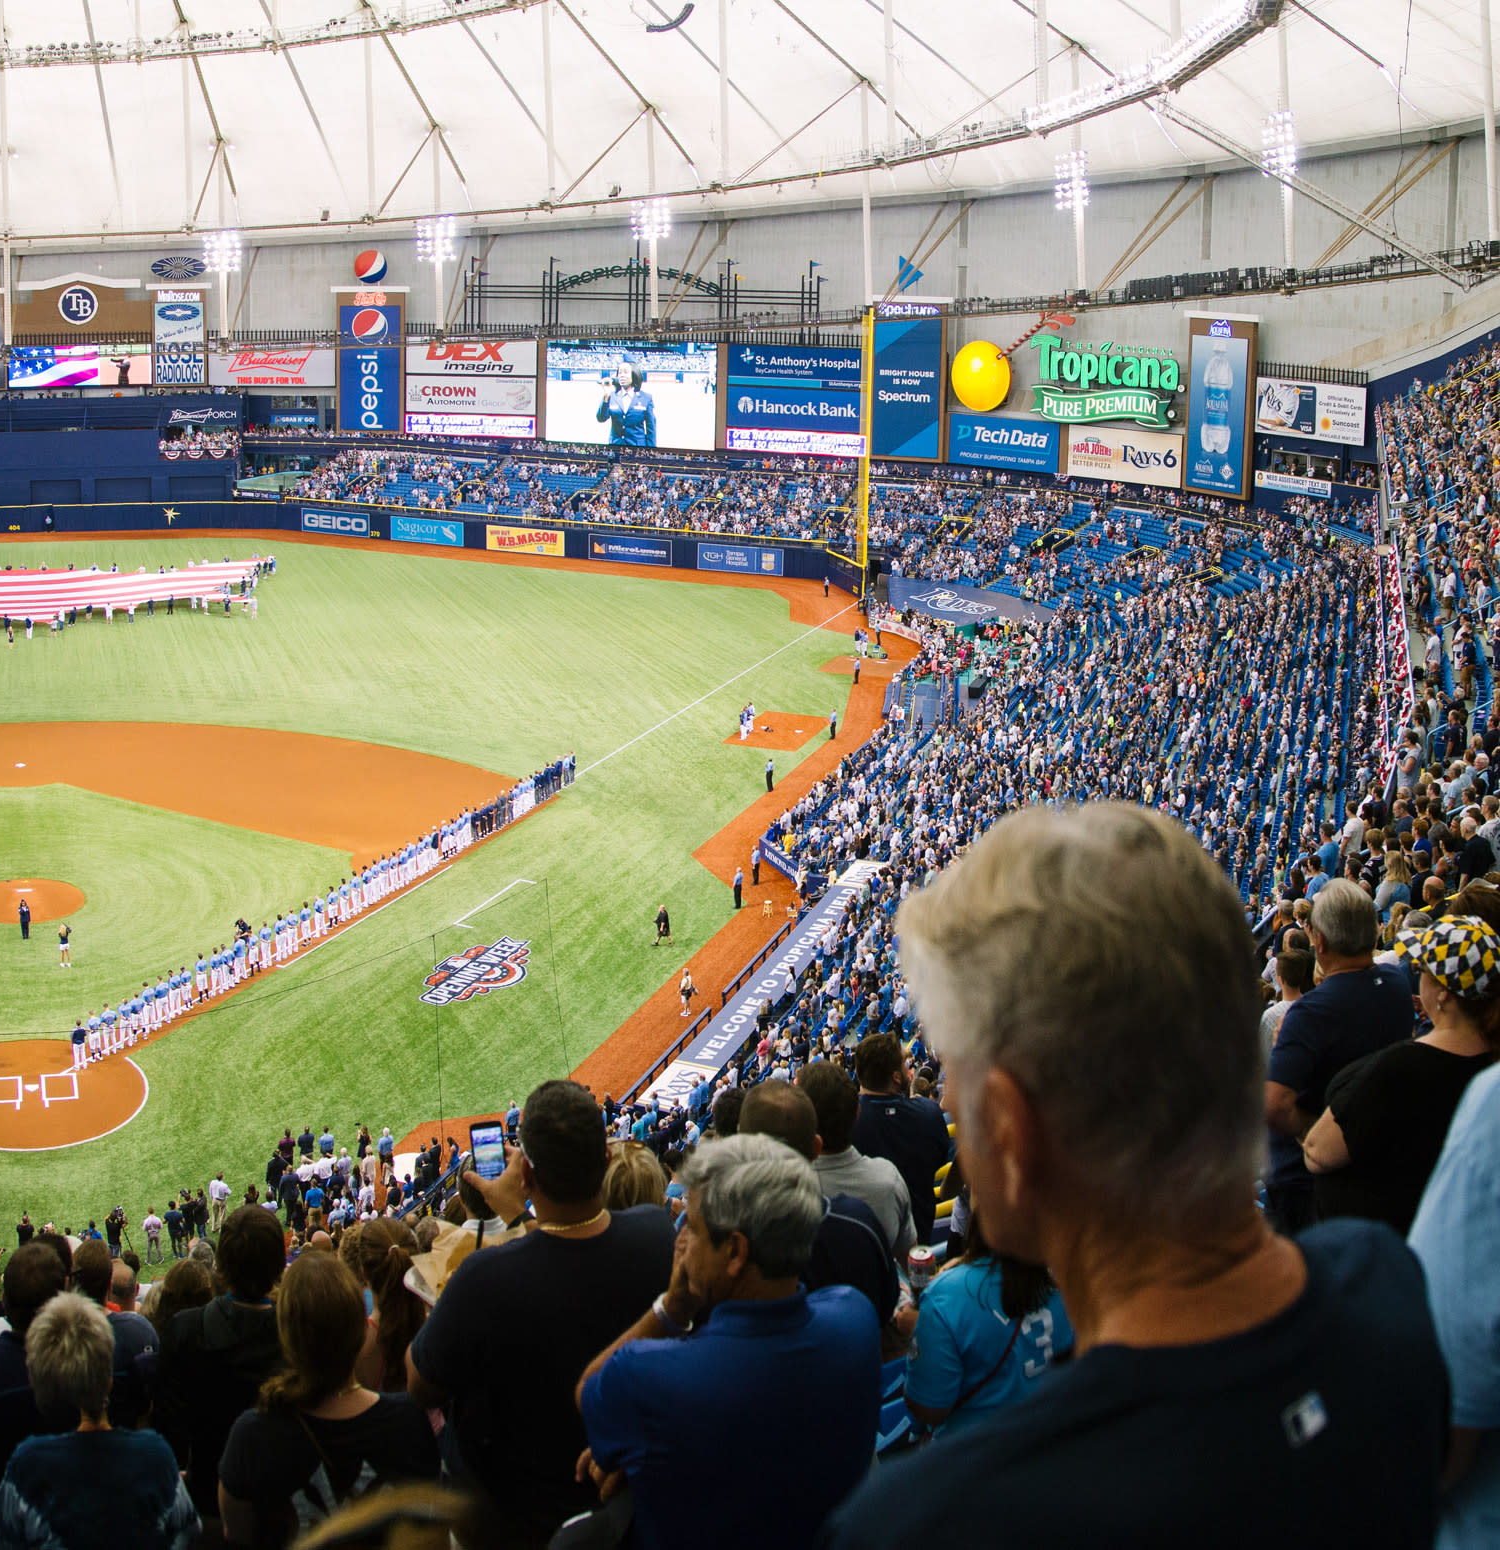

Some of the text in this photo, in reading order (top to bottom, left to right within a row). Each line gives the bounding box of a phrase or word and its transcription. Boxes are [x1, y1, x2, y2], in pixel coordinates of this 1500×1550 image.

[65, 292, 93, 318] TB
[156, 342, 204, 364] ROSE
[425, 341, 507, 361] DEX
[1066, 341, 1173, 356] THE ORIGINAL
[238, 354, 307, 366] Budweiser
[444, 361, 514, 373] imaging
[755, 356, 860, 371] St. Anthony's Hospital
[1030, 334, 1179, 391] Tropicana
[156, 364, 204, 383] RADIOLOGY
[879, 369, 935, 378] BRIGHT HOUSE
[357, 353, 383, 429] pepsi
[421, 385, 476, 397] CROWN
[878, 390, 930, 403] Spectrum
[427, 398, 476, 406] AUTOMOTIVE
[755, 399, 858, 418] Hancock Bank
[1043, 395, 1157, 417] PURE PREMIUM
[1332, 420, 1360, 429] Suncoast
[1072, 442, 1090, 454] PAPA
[1122, 445, 1177, 469] RAYS 6
[959, 451, 983, 459] PROUDLY
[984, 453, 1017, 463] SUPPORTING
[1018, 456, 1035, 464] TAMPA
[1072, 459, 1092, 467] BETTER
[304, 513, 367, 532] GEICO
[397, 518, 438, 536] Sagicor
[609, 545, 666, 556] MicroLumen
[706, 552, 723, 560] TGH
[909, 587, 997, 615] RAYS
[422, 938, 527, 1003] OPENING WEEK
[695, 888, 857, 1061] WELCOME TO TROPICANA FIELD
[1021, 1308, 1053, 1378] 3
